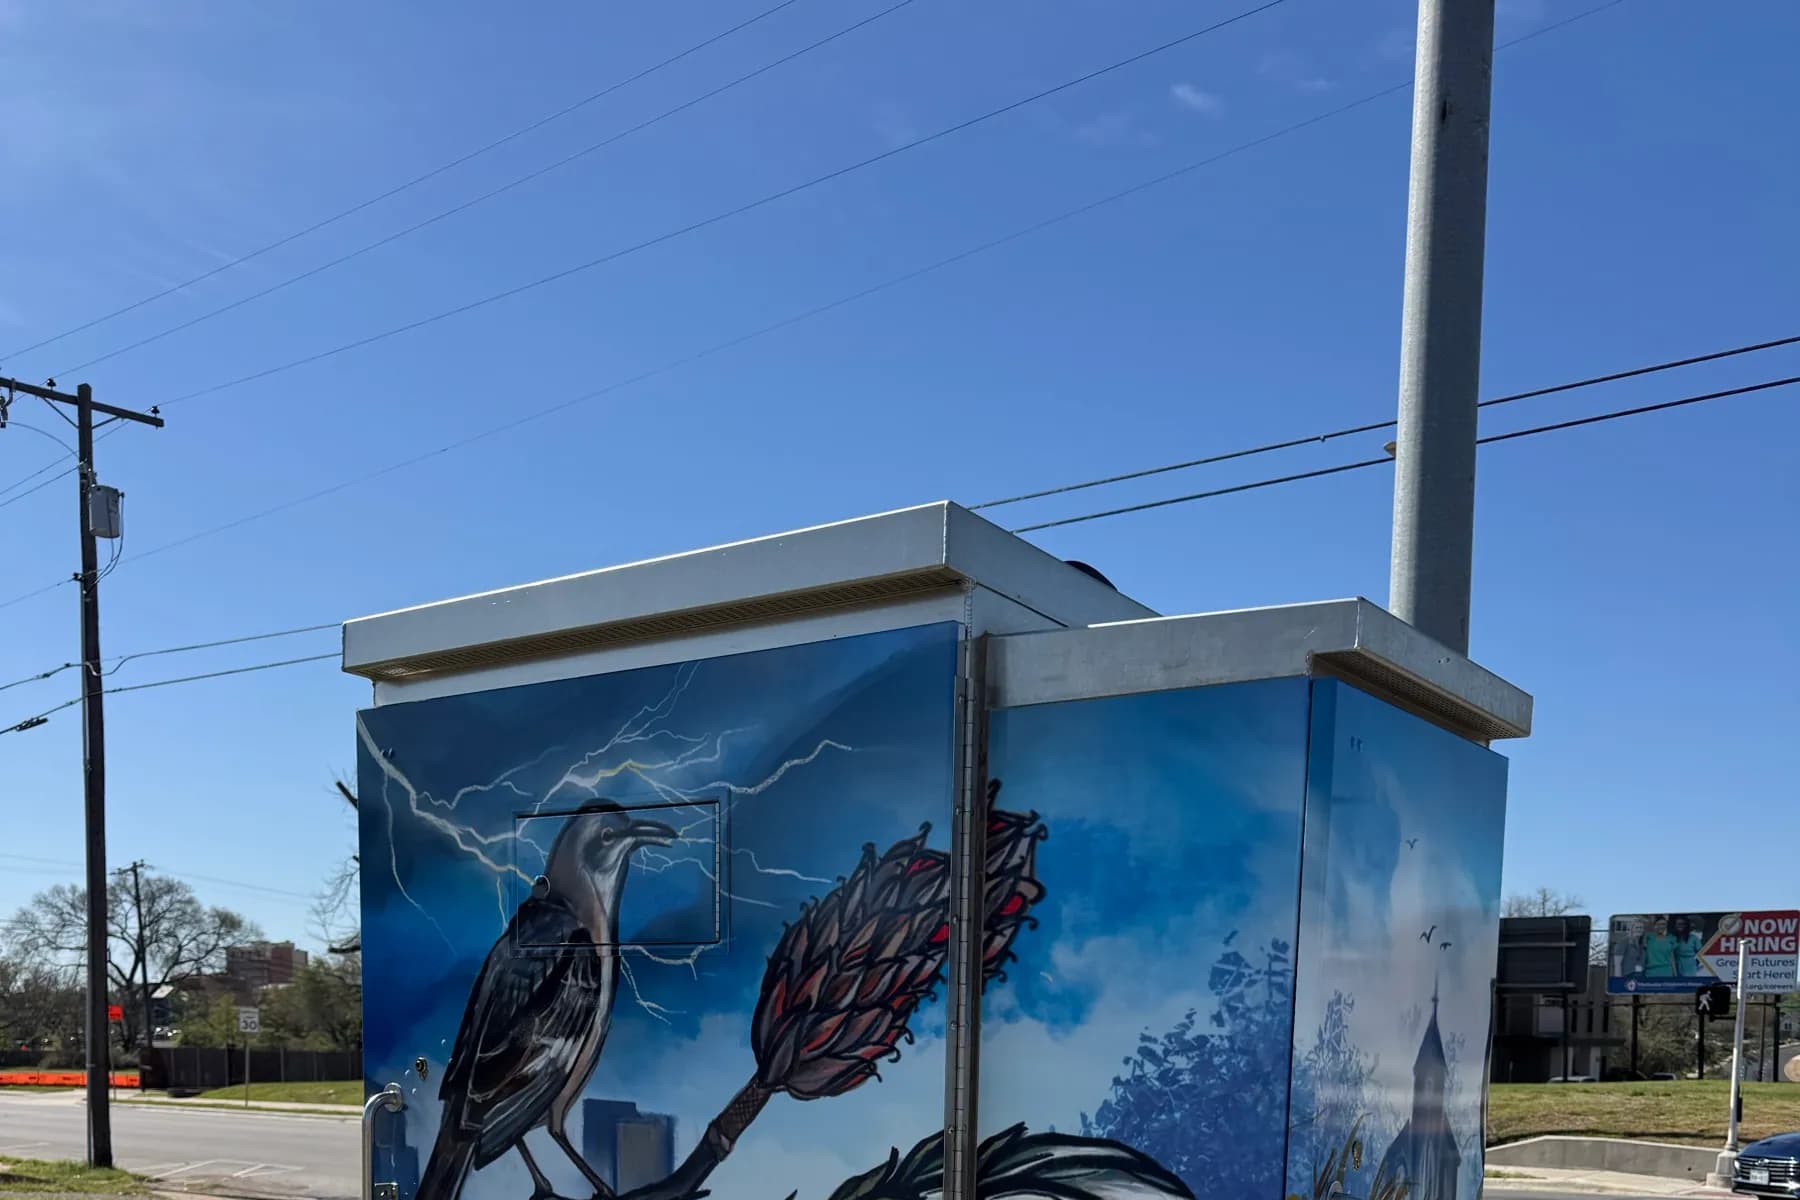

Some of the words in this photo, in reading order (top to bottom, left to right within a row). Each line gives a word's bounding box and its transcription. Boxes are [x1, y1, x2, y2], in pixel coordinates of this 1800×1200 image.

[1744, 918, 1798, 934] NOW
[1720, 937, 1796, 952] HIRING
[1751, 958, 1795, 967] Futures
[1763, 969, 1794, 979] Here!
[241, 1019, 257, 1030] 30
